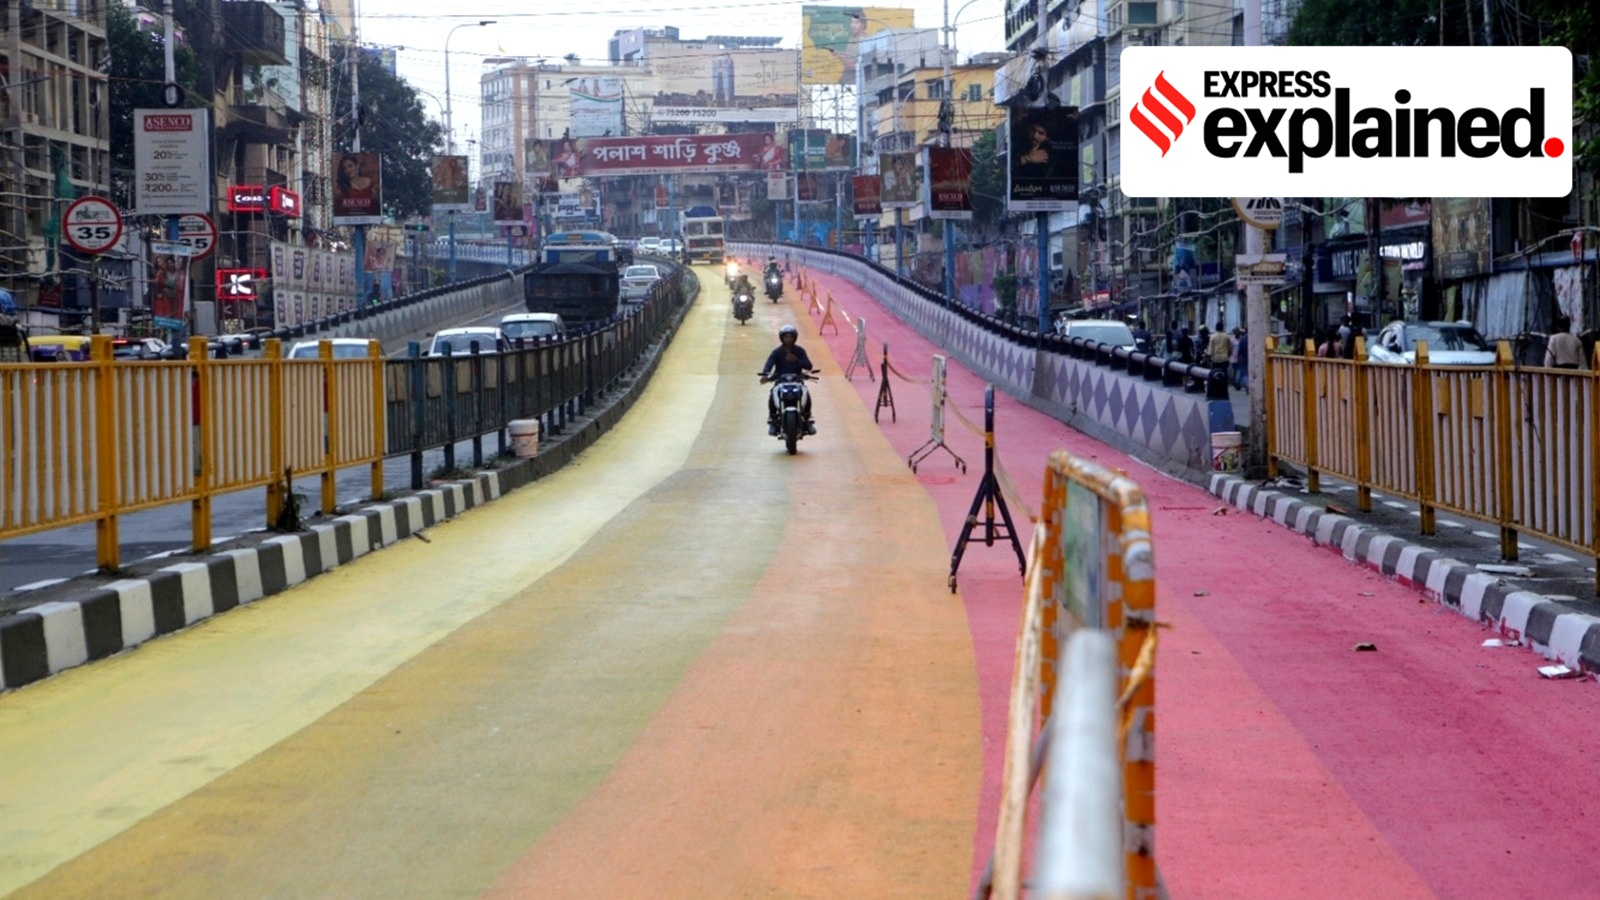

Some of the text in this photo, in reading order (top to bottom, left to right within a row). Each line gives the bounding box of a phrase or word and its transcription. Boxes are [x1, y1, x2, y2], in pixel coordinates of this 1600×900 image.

[665, 109, 717, 117] 75200 75200
[153, 116, 191, 127] SENCO
[593, 138, 741, 163] পলাশ শাড়ি কুঞ্জ
[77, 226, 111, 240] 35
